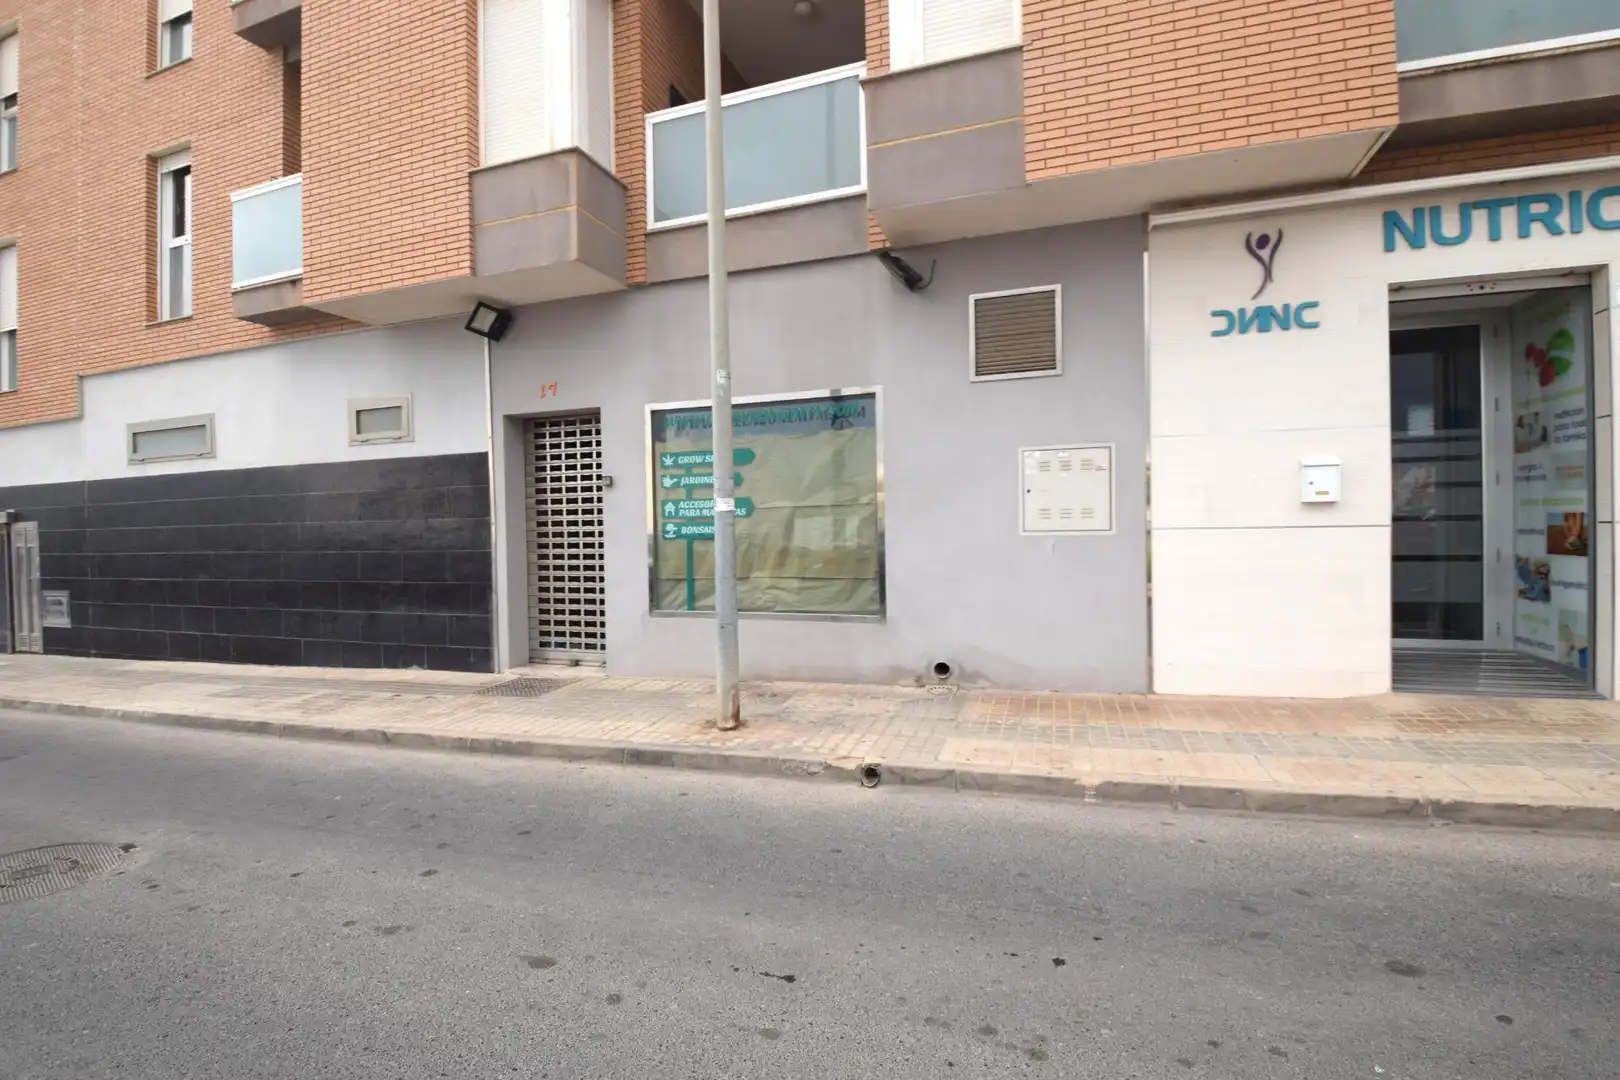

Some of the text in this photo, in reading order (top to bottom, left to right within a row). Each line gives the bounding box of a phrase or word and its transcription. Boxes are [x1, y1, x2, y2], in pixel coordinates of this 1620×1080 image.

[678, 455, 705, 464] GROW
[680, 475, 716, 486] JARDINE
[678, 500, 716, 509] ACCESOR
[679, 508, 701, 517] PARA
